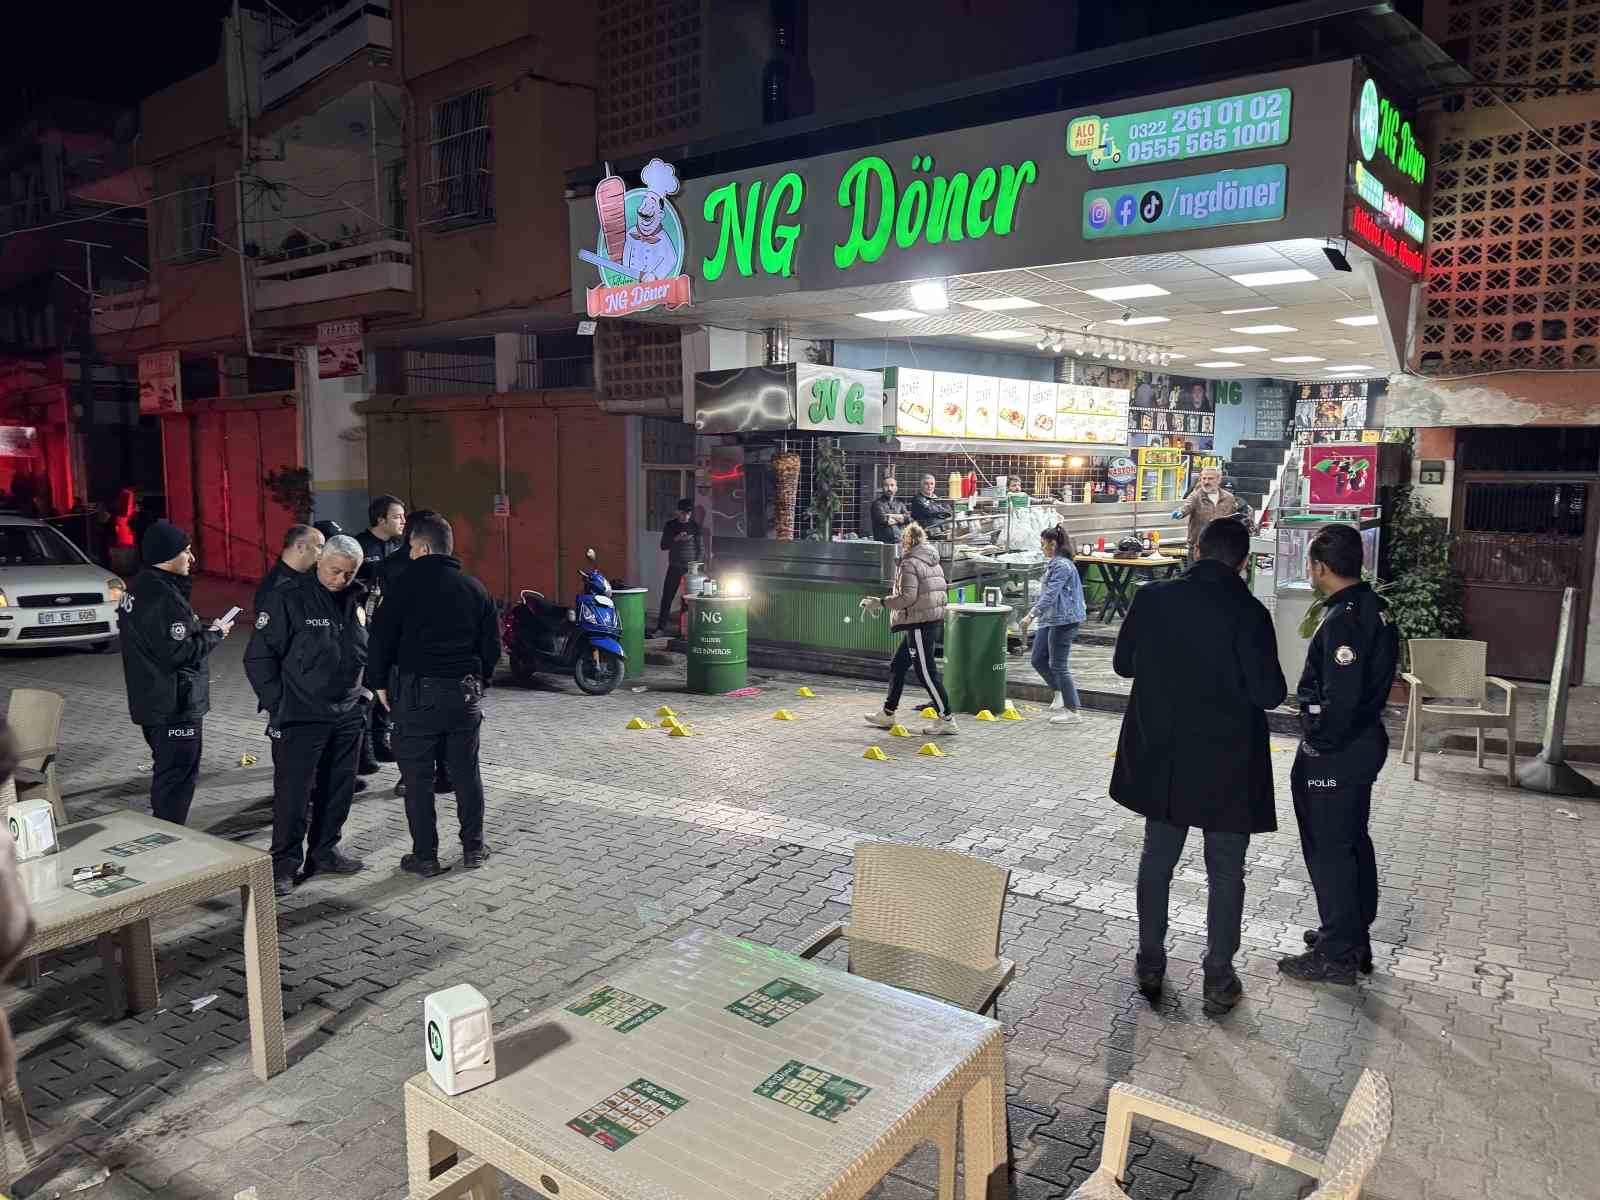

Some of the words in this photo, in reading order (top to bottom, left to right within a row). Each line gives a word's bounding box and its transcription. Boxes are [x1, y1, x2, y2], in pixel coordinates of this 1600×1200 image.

[1075, 123, 1095, 139] ALO
[1129, 120, 1167, 139] 0322
[1172, 106, 1211, 132] 261
[1217, 100, 1245, 126] 01
[1248, 93, 1283, 121] 02
[1074, 137, 1096, 149] PAKET
[1127, 137, 1180, 162] 0555
[1186, 128, 1227, 155] 565
[1232, 118, 1281, 146] 1001
[1167, 179, 1281, 219] /ngdöner
[702, 172, 804, 281] NG
[833, 155, 1038, 269] Döner
[605, 289, 628, 313] NG
[631, 284, 671, 305] Döner
[808, 379, 865, 425] NG
[1216, 381, 1243, 405] NG
[702, 611, 722, 624] NG
